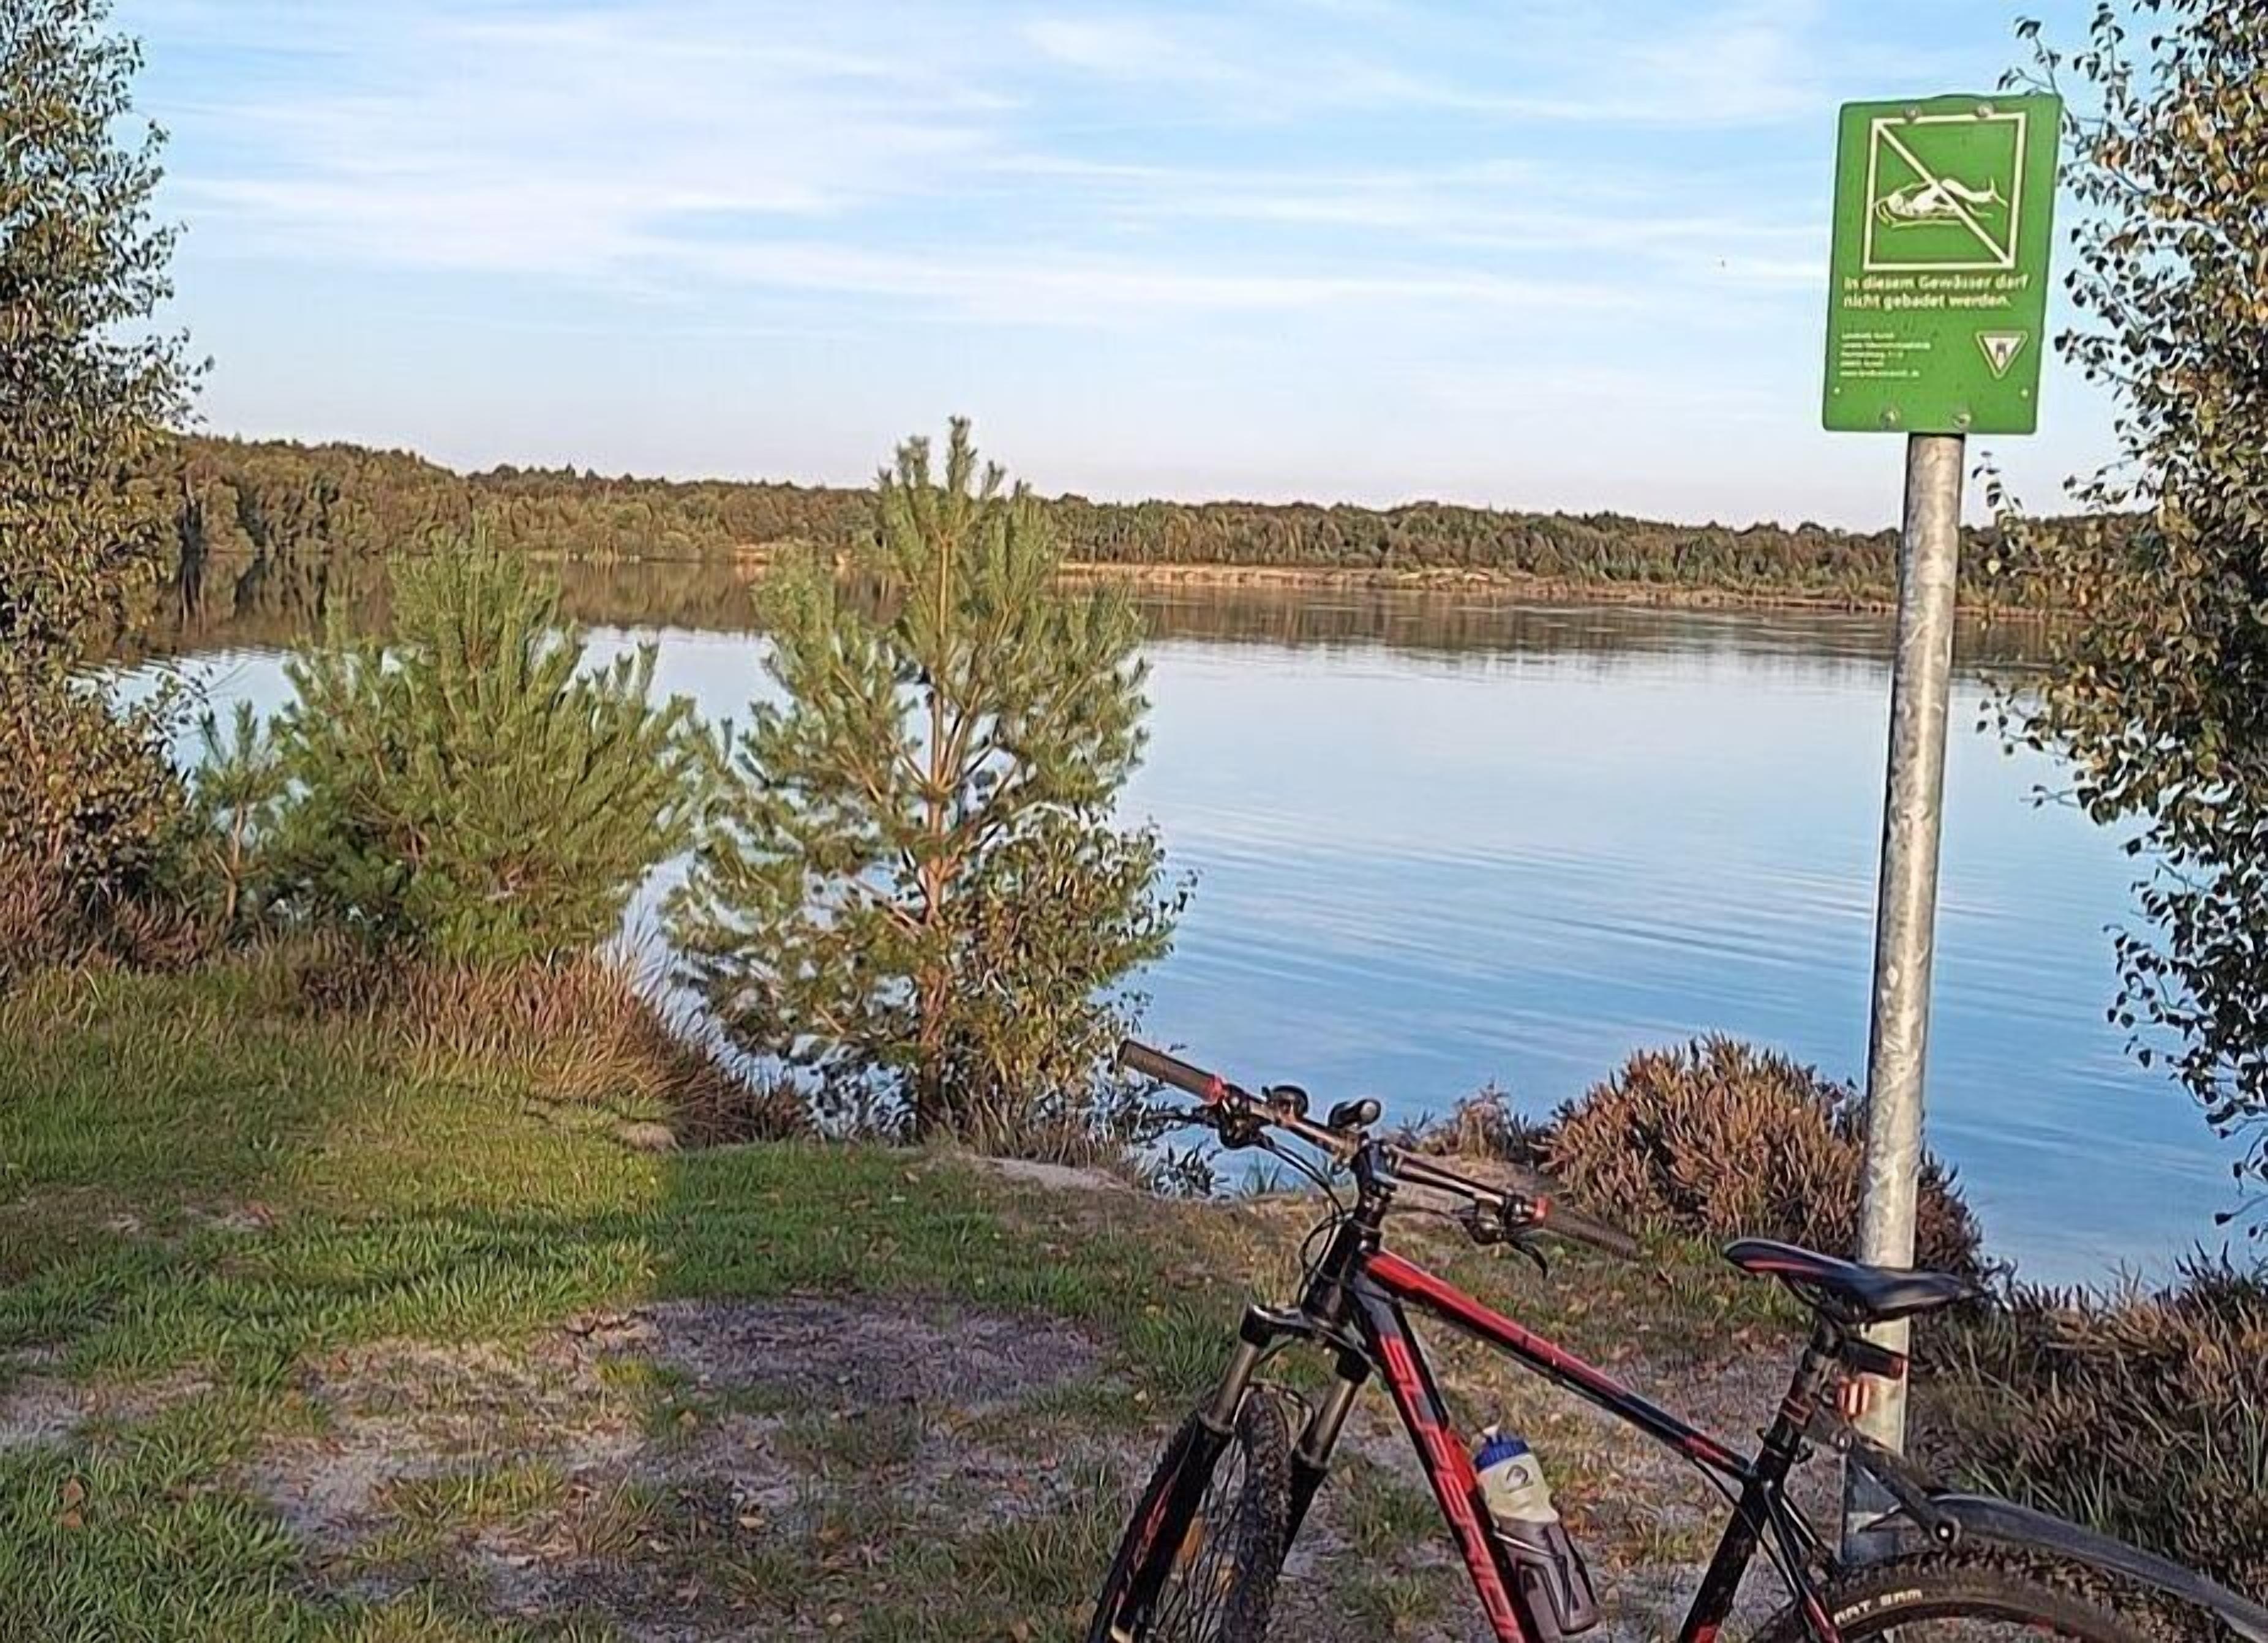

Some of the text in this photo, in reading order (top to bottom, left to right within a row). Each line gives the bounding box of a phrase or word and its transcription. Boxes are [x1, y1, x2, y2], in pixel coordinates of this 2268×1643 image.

[1843, 277, 1860, 291] In
[1863, 275, 1915, 291] diesem
[1994, 274, 2029, 290] darf
[1844, 293, 1882, 309] nicht
[1883, 293, 1946, 312] gebadet
